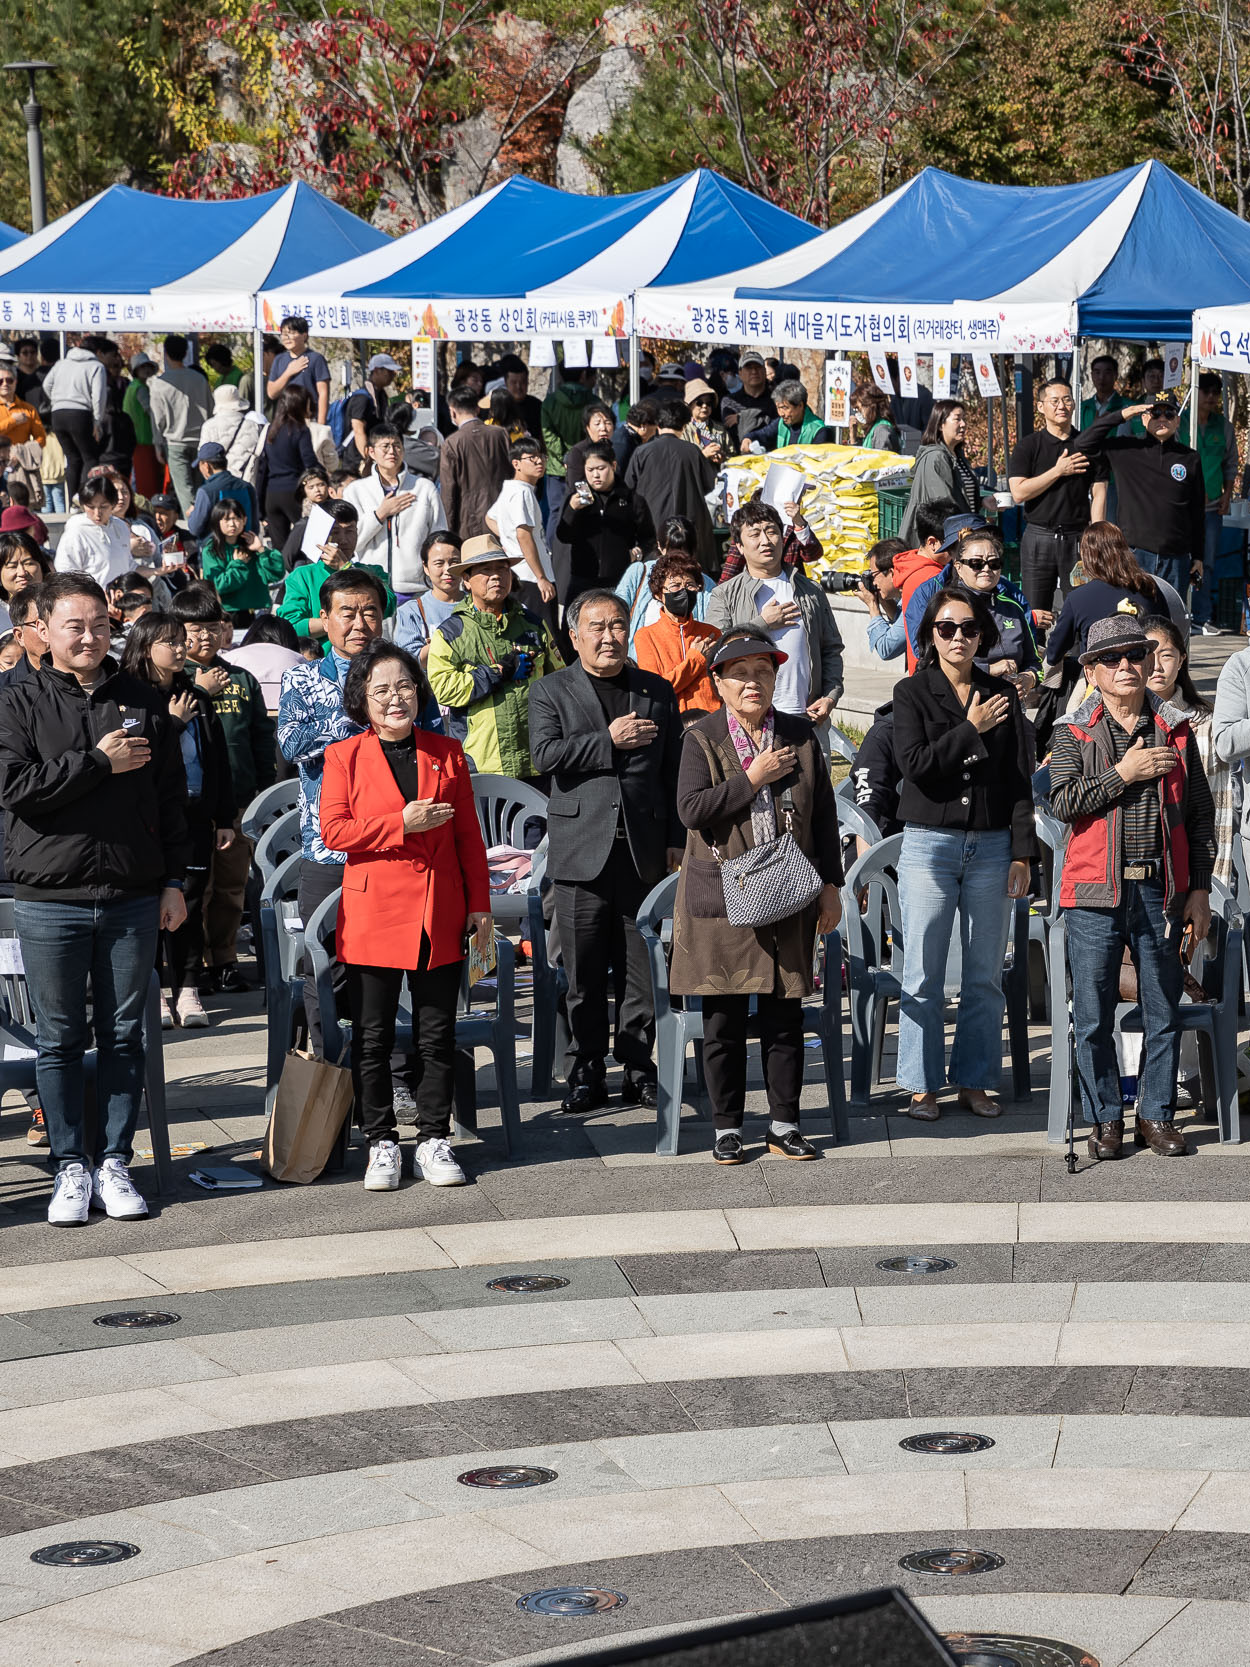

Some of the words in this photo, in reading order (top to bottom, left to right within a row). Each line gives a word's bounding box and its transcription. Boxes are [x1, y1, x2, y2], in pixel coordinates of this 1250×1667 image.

[316, 304, 350, 330] 상인회
[454, 308, 492, 333] 광장동
[499, 307, 538, 333] 상인회
[691, 306, 729, 335] 광장동
[735, 309, 774, 338] 체육회
[784, 312, 911, 343] 새마을지도자협의회
